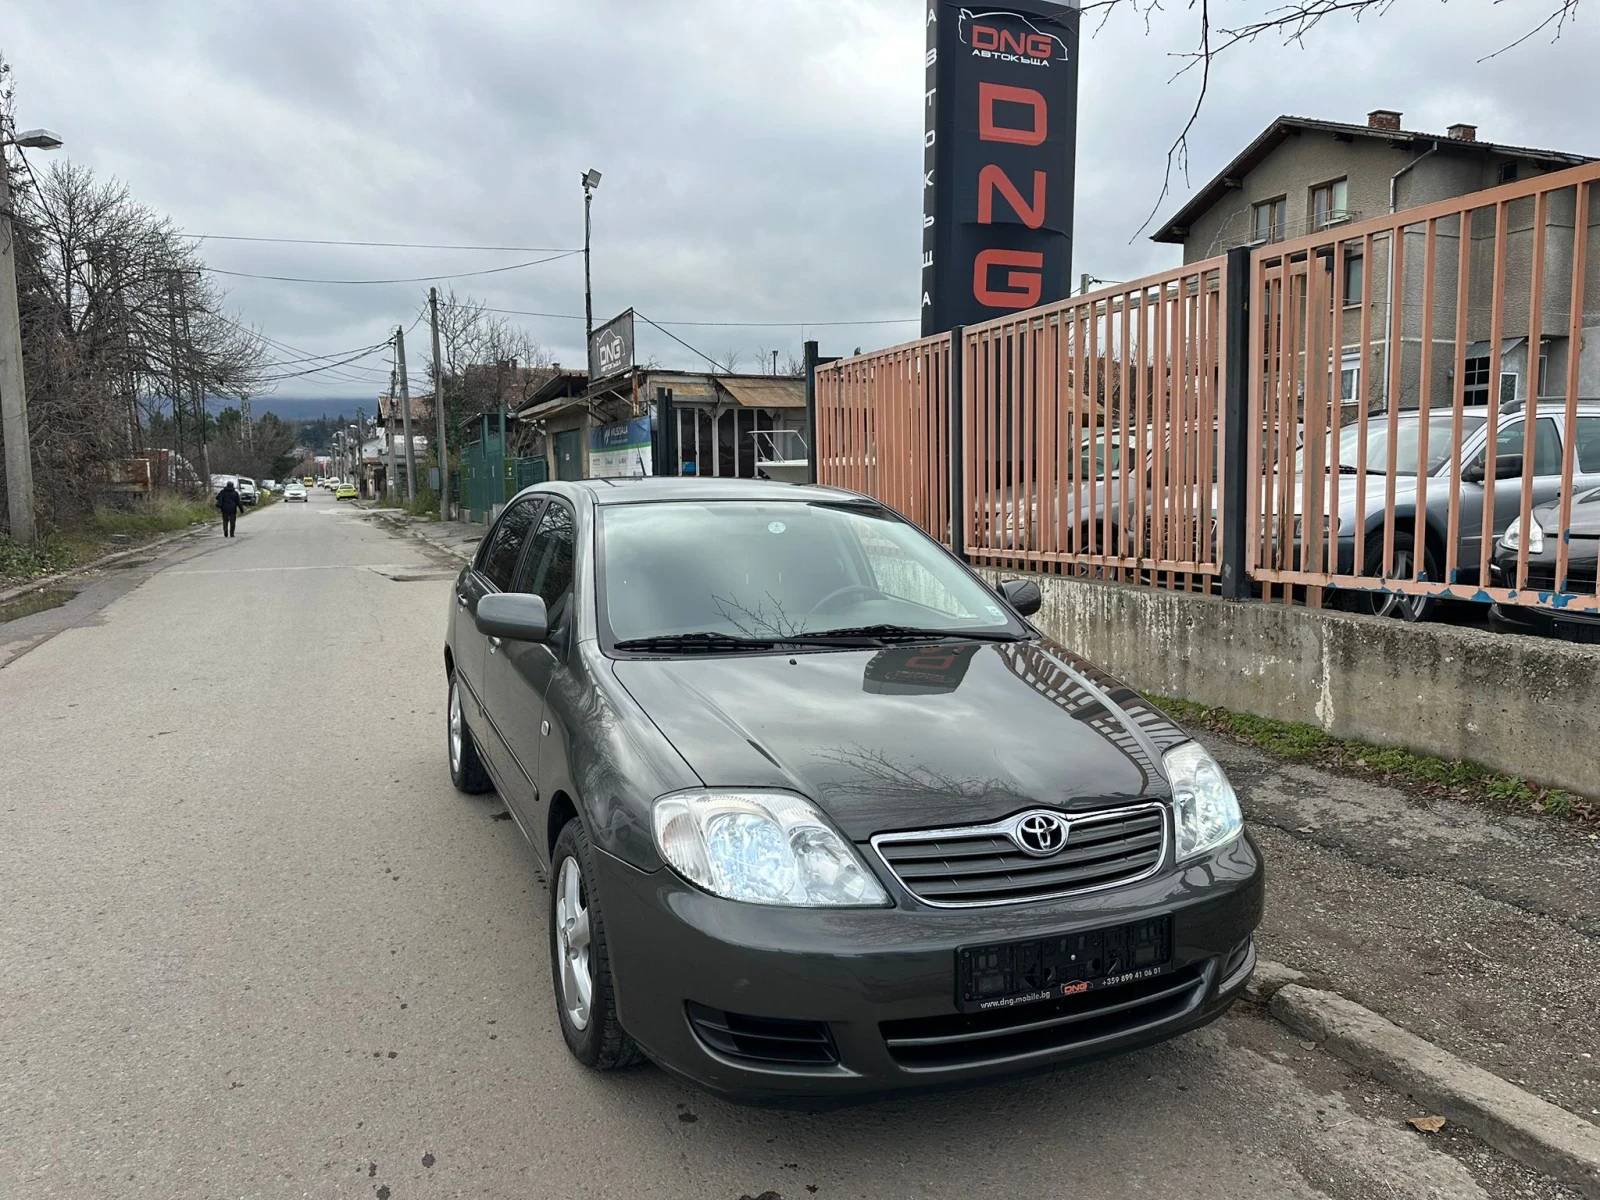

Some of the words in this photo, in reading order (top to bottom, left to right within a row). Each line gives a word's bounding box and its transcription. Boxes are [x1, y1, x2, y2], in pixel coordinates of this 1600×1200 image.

[972, 25, 1052, 59] DNG
[972, 49, 1050, 67] АВТОКЪЩА
[973, 81, 1047, 309] DNG
[600, 338, 620, 366] DNG
[1102, 976, 1120, 986] +359
[1120, 972, 1134, 982] 899
[1134, 971, 1143, 979] 41
[1153, 966, 1161, 975] 01
[1063, 982, 1088, 994] DNG
[980, 990, 1051, 1009] www.dng.mobile.bg
